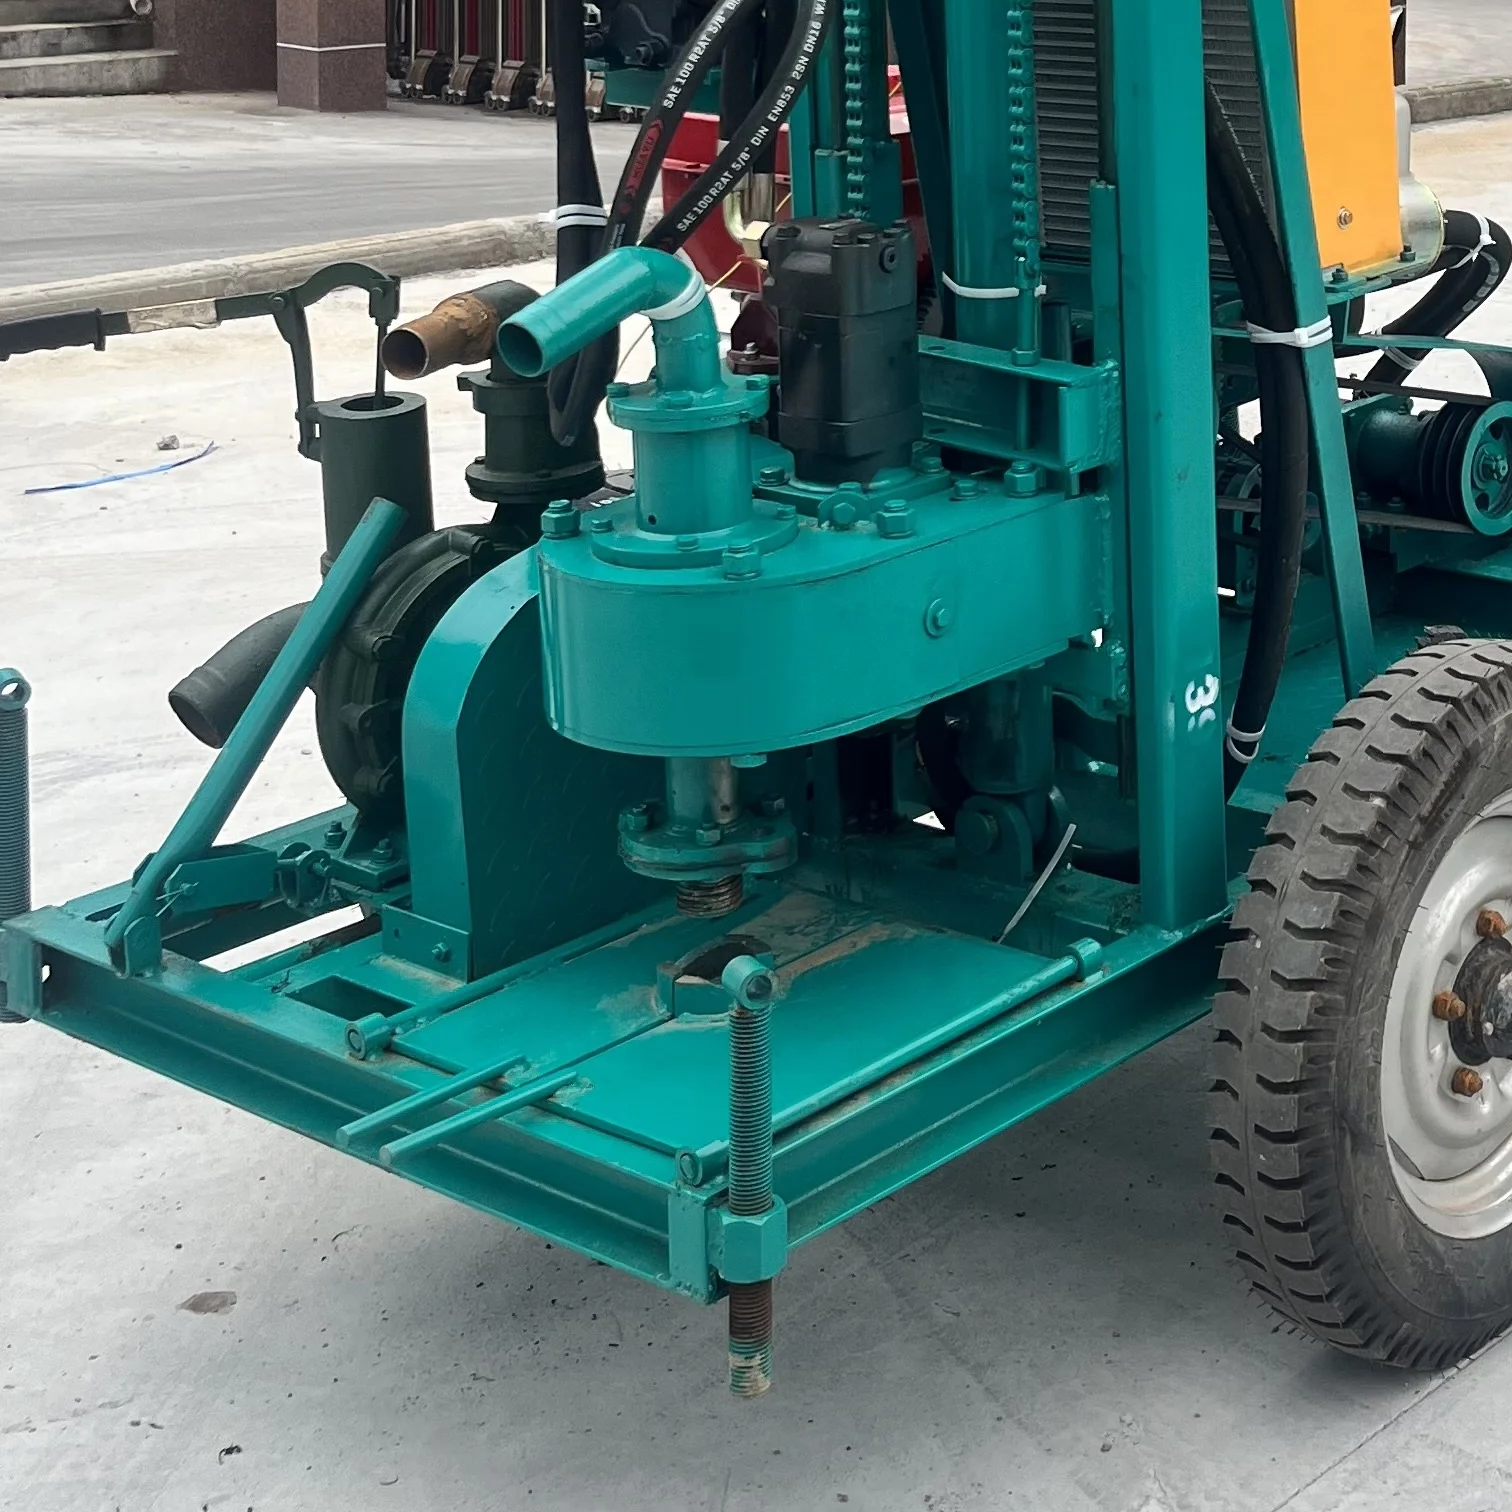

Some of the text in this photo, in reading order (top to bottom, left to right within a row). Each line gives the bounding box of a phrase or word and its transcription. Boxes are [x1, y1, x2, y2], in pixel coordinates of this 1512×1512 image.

[662, 85, 682, 109] SAE
[676, 212, 697, 232] SAE
[750, 125, 770, 146] DIN
[767, 85, 796, 122] EN853
